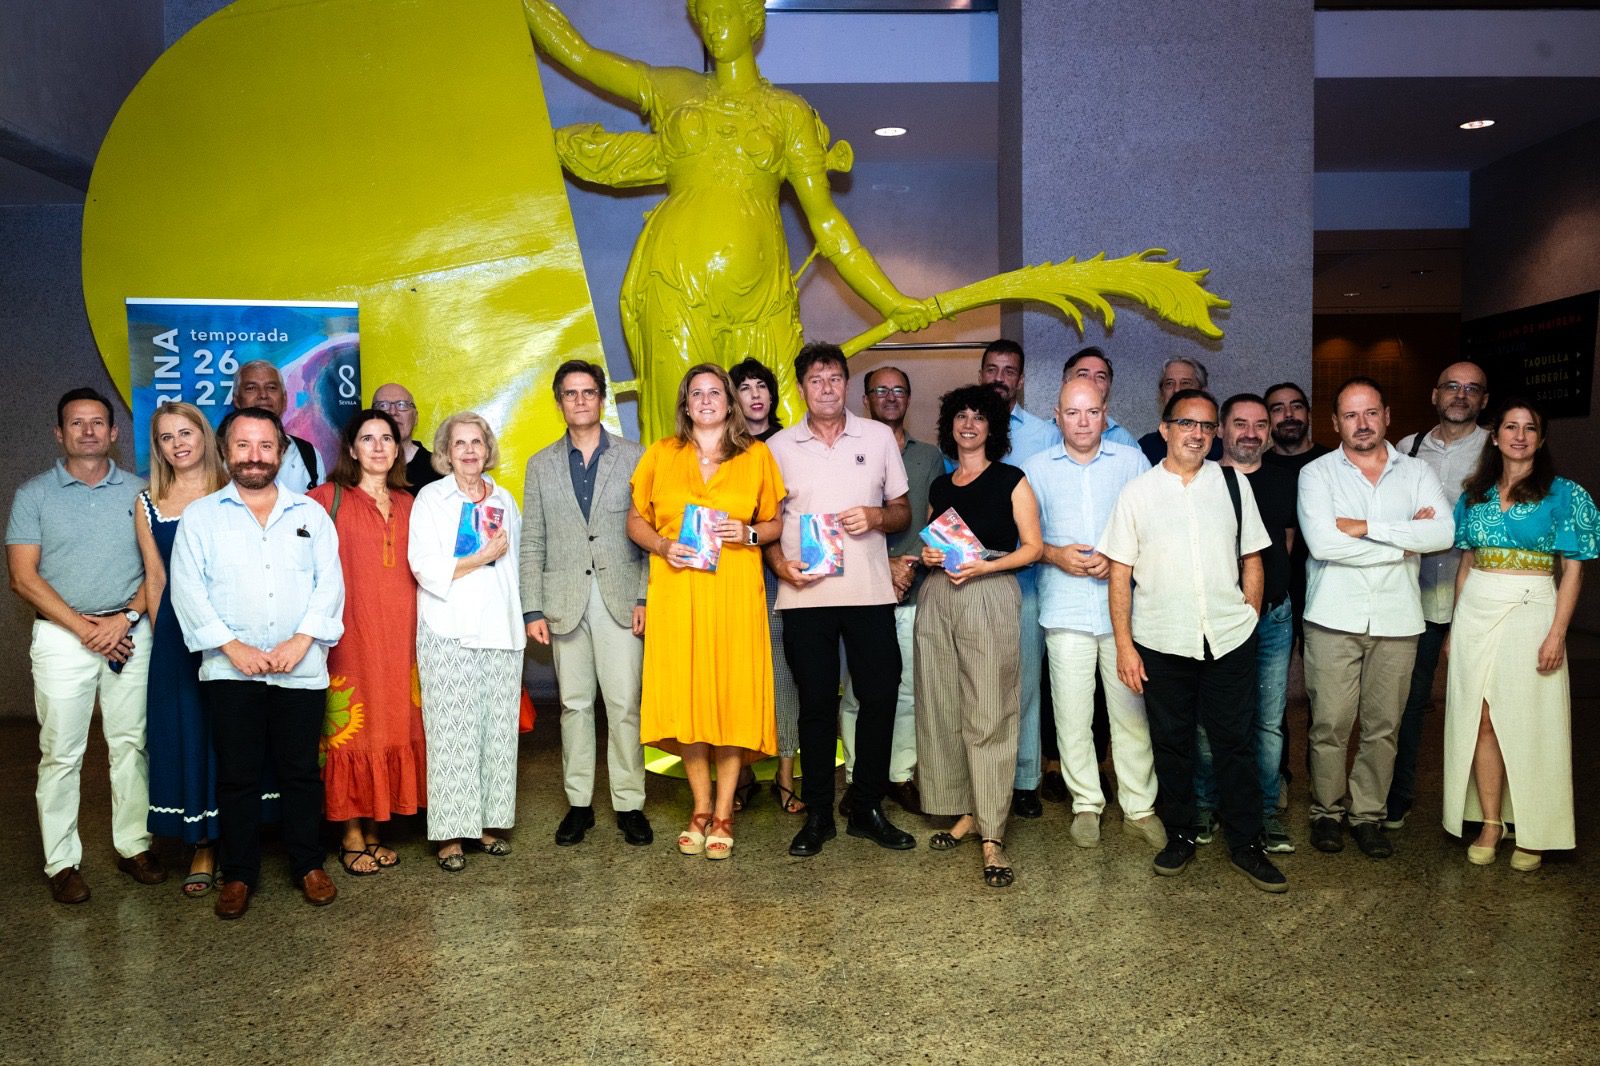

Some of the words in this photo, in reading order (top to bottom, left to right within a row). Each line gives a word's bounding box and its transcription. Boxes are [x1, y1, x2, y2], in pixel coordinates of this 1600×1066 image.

[190, 328, 289, 344] temporada
[193, 349, 239, 375] 26
[1523, 352, 1569, 369] TAQUILLA
[1526, 368, 1569, 385] LIBRERÍA
[194, 380, 234, 406] 27
[1537, 388, 1569, 401] SALIDA
